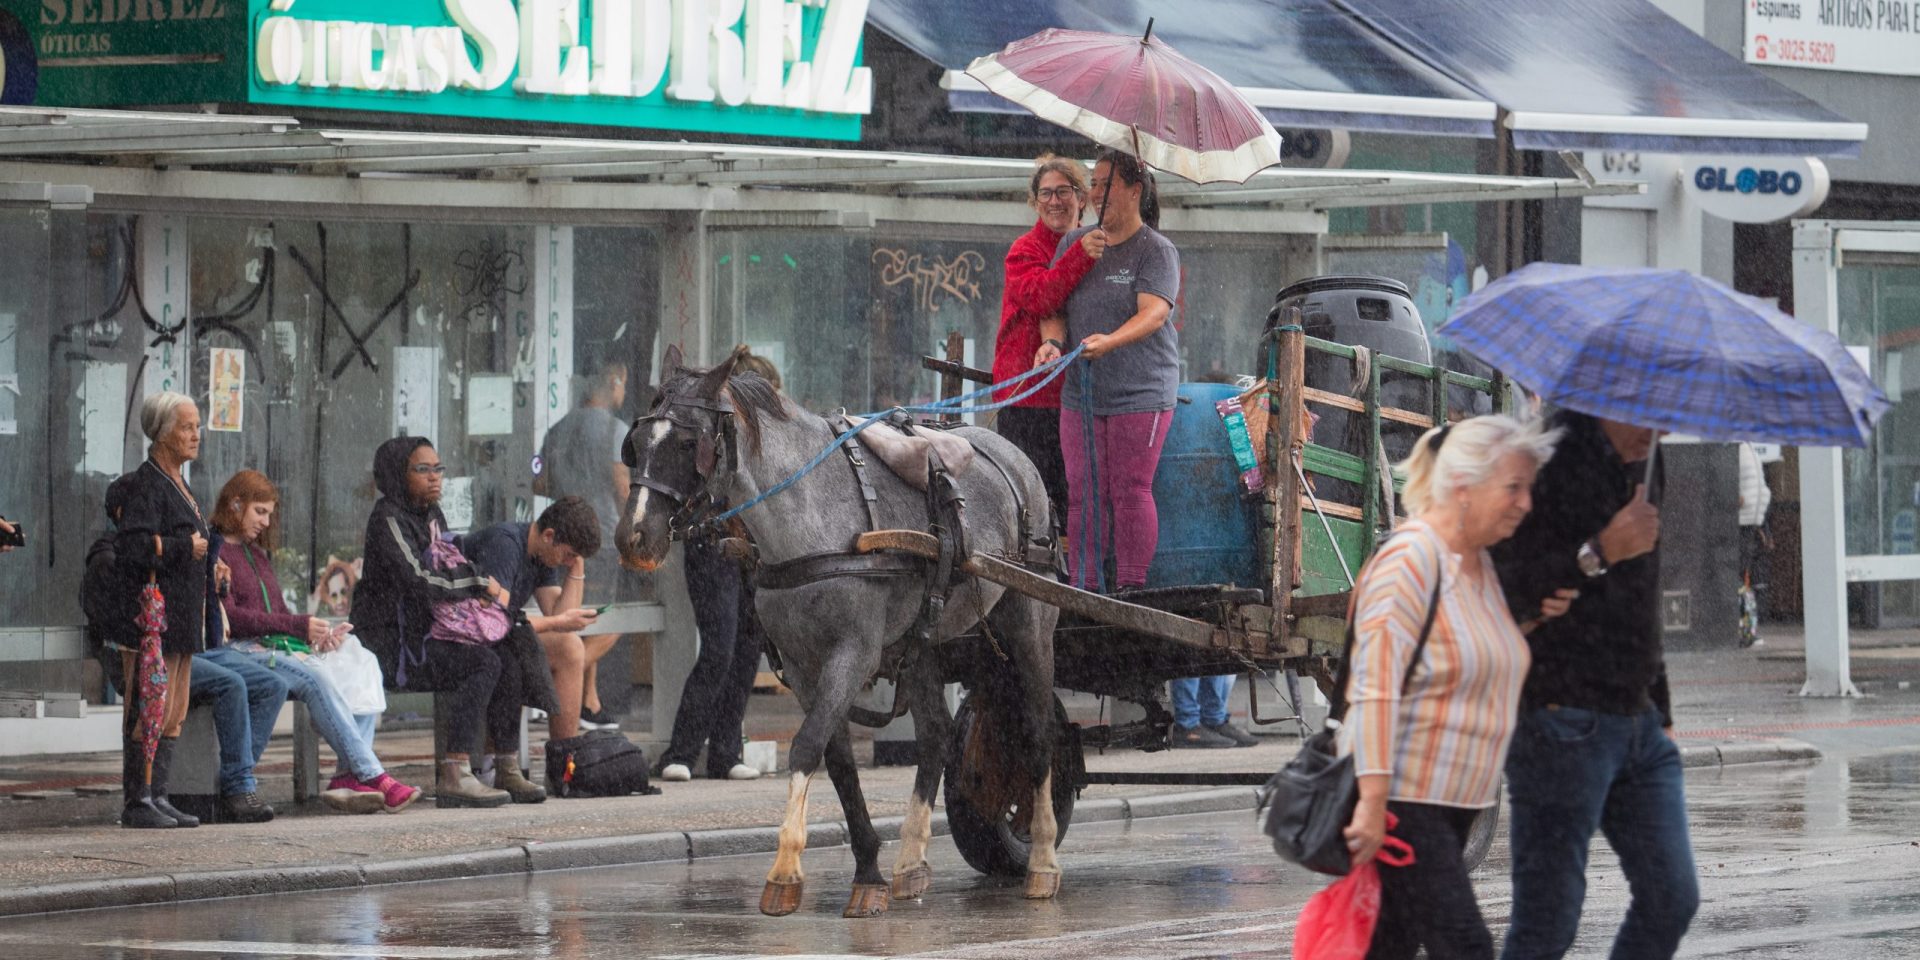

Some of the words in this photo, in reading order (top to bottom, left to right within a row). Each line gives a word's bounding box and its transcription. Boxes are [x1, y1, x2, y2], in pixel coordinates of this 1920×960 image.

[1818, 0, 1873, 29] ARTIGOS
[1877, 0, 1909, 32] PARA
[41, 31, 112, 53] ÓTICAS
[443, 0, 872, 114] SEDREZ
[1695, 167, 1801, 195] GLOBO
